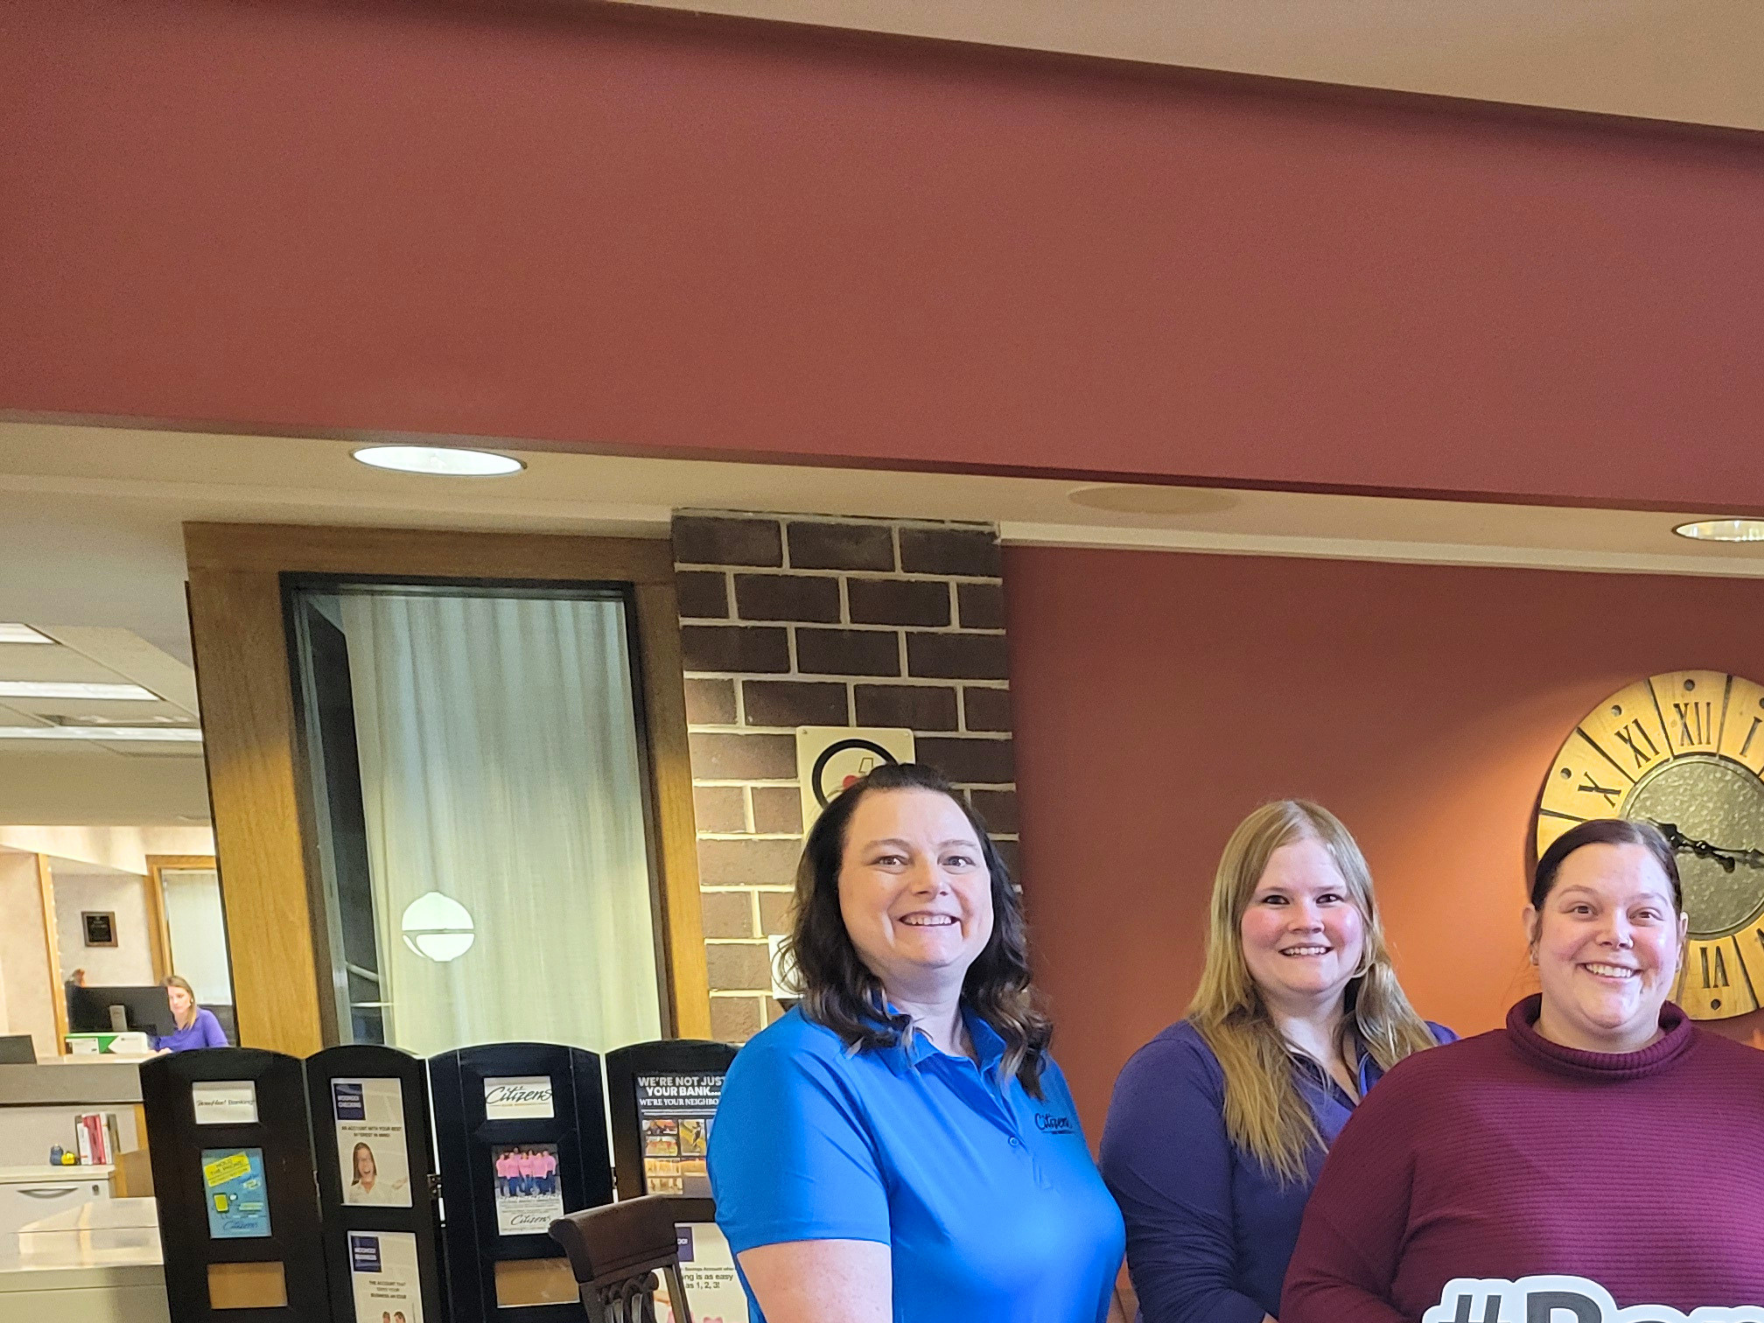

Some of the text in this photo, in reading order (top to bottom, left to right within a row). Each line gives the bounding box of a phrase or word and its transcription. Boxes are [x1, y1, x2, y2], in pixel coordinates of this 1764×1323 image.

[675, 1076, 699, 1086] NOT
[486, 1085, 553, 1104] Citizens
[646, 1087, 677, 1096] YOUR
[664, 1098, 684, 1106] YOUR
[715, 1274, 734, 1282] easy
